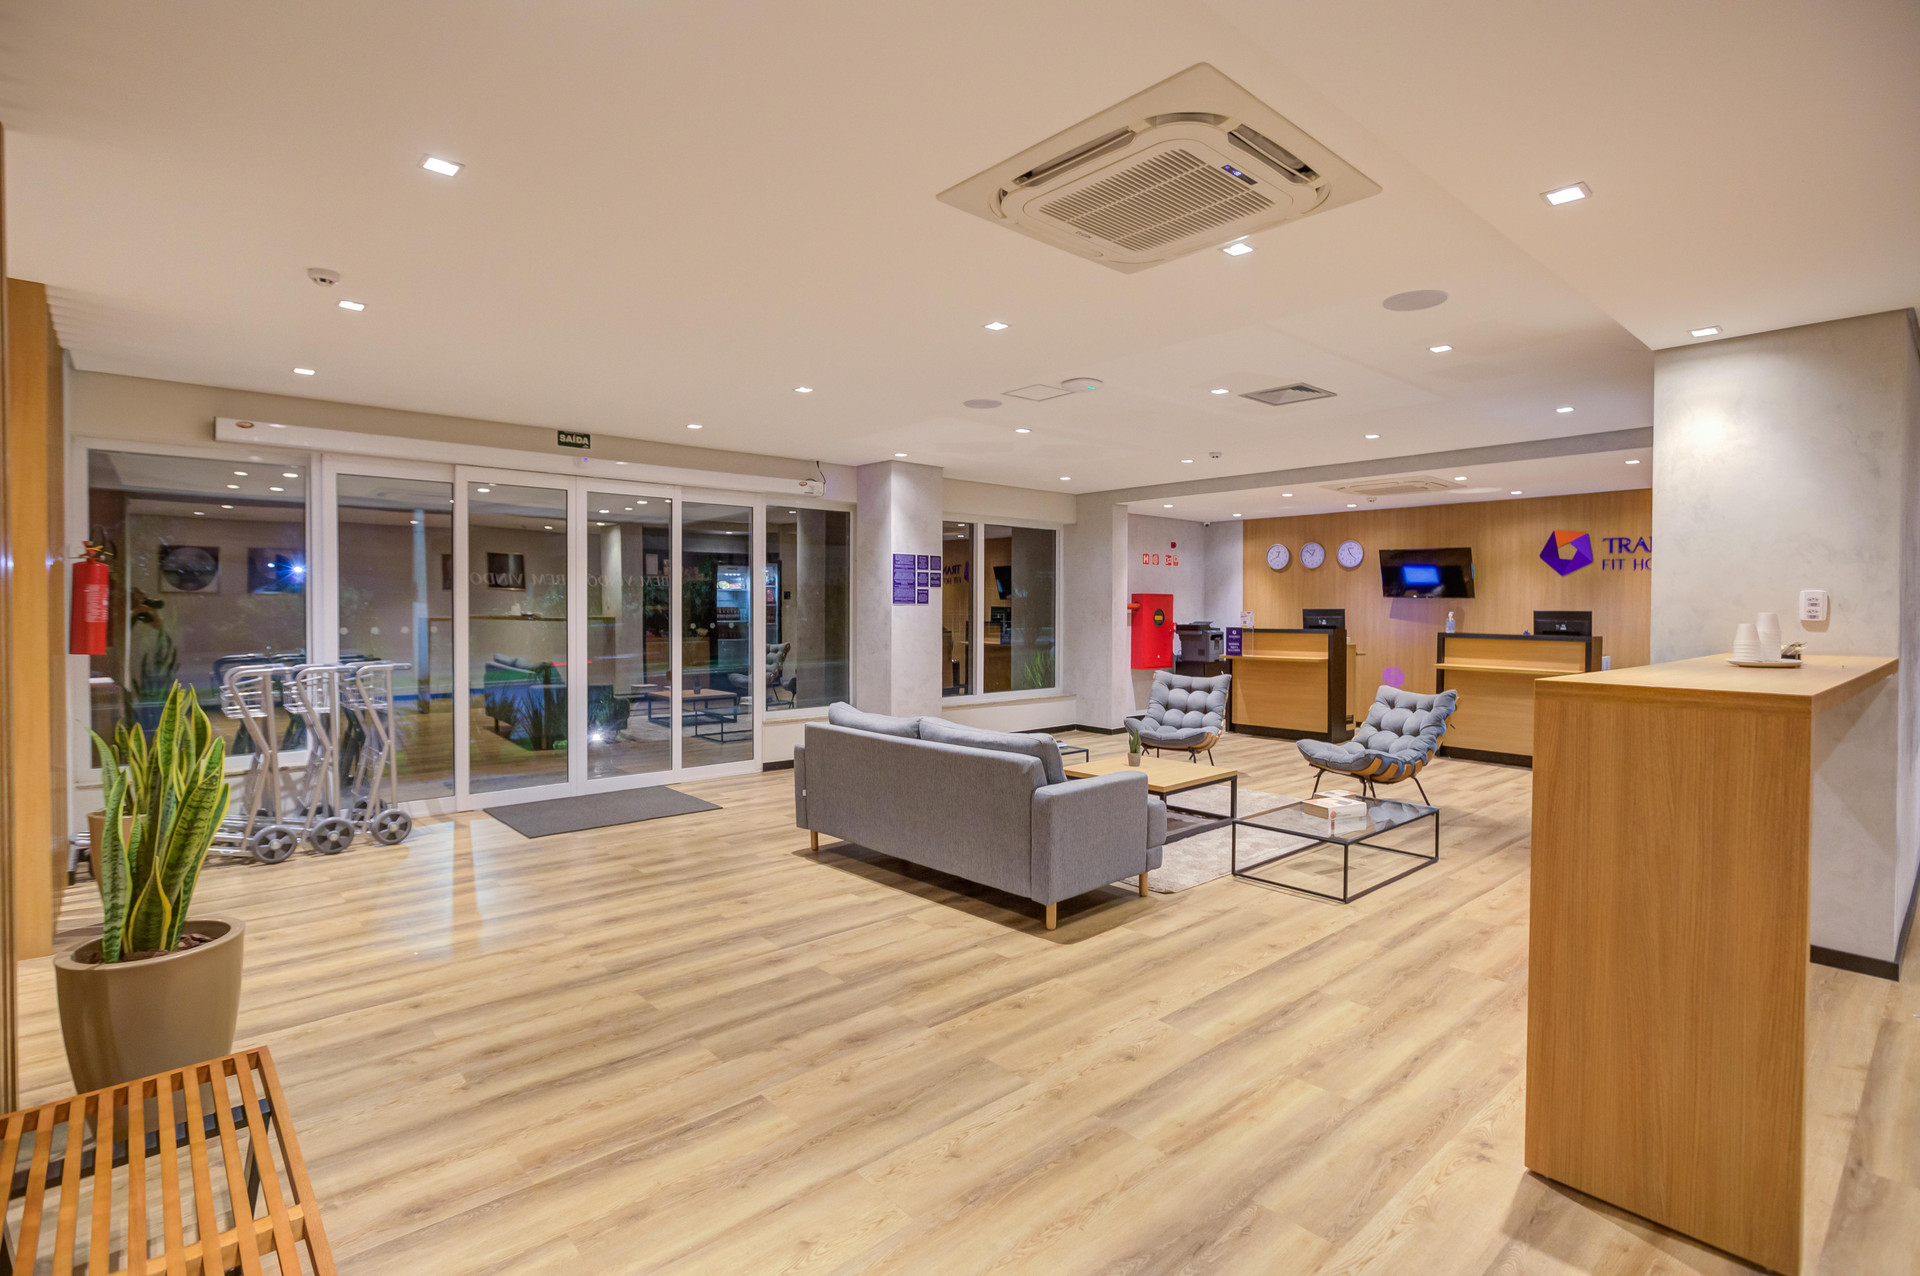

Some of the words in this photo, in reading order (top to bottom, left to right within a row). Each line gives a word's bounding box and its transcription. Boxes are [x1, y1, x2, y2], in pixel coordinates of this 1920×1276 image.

[559, 433, 589, 445] SAÍDA
[1602, 536, 1652, 554] TRA
[1602, 558, 1626, 570] FIT
